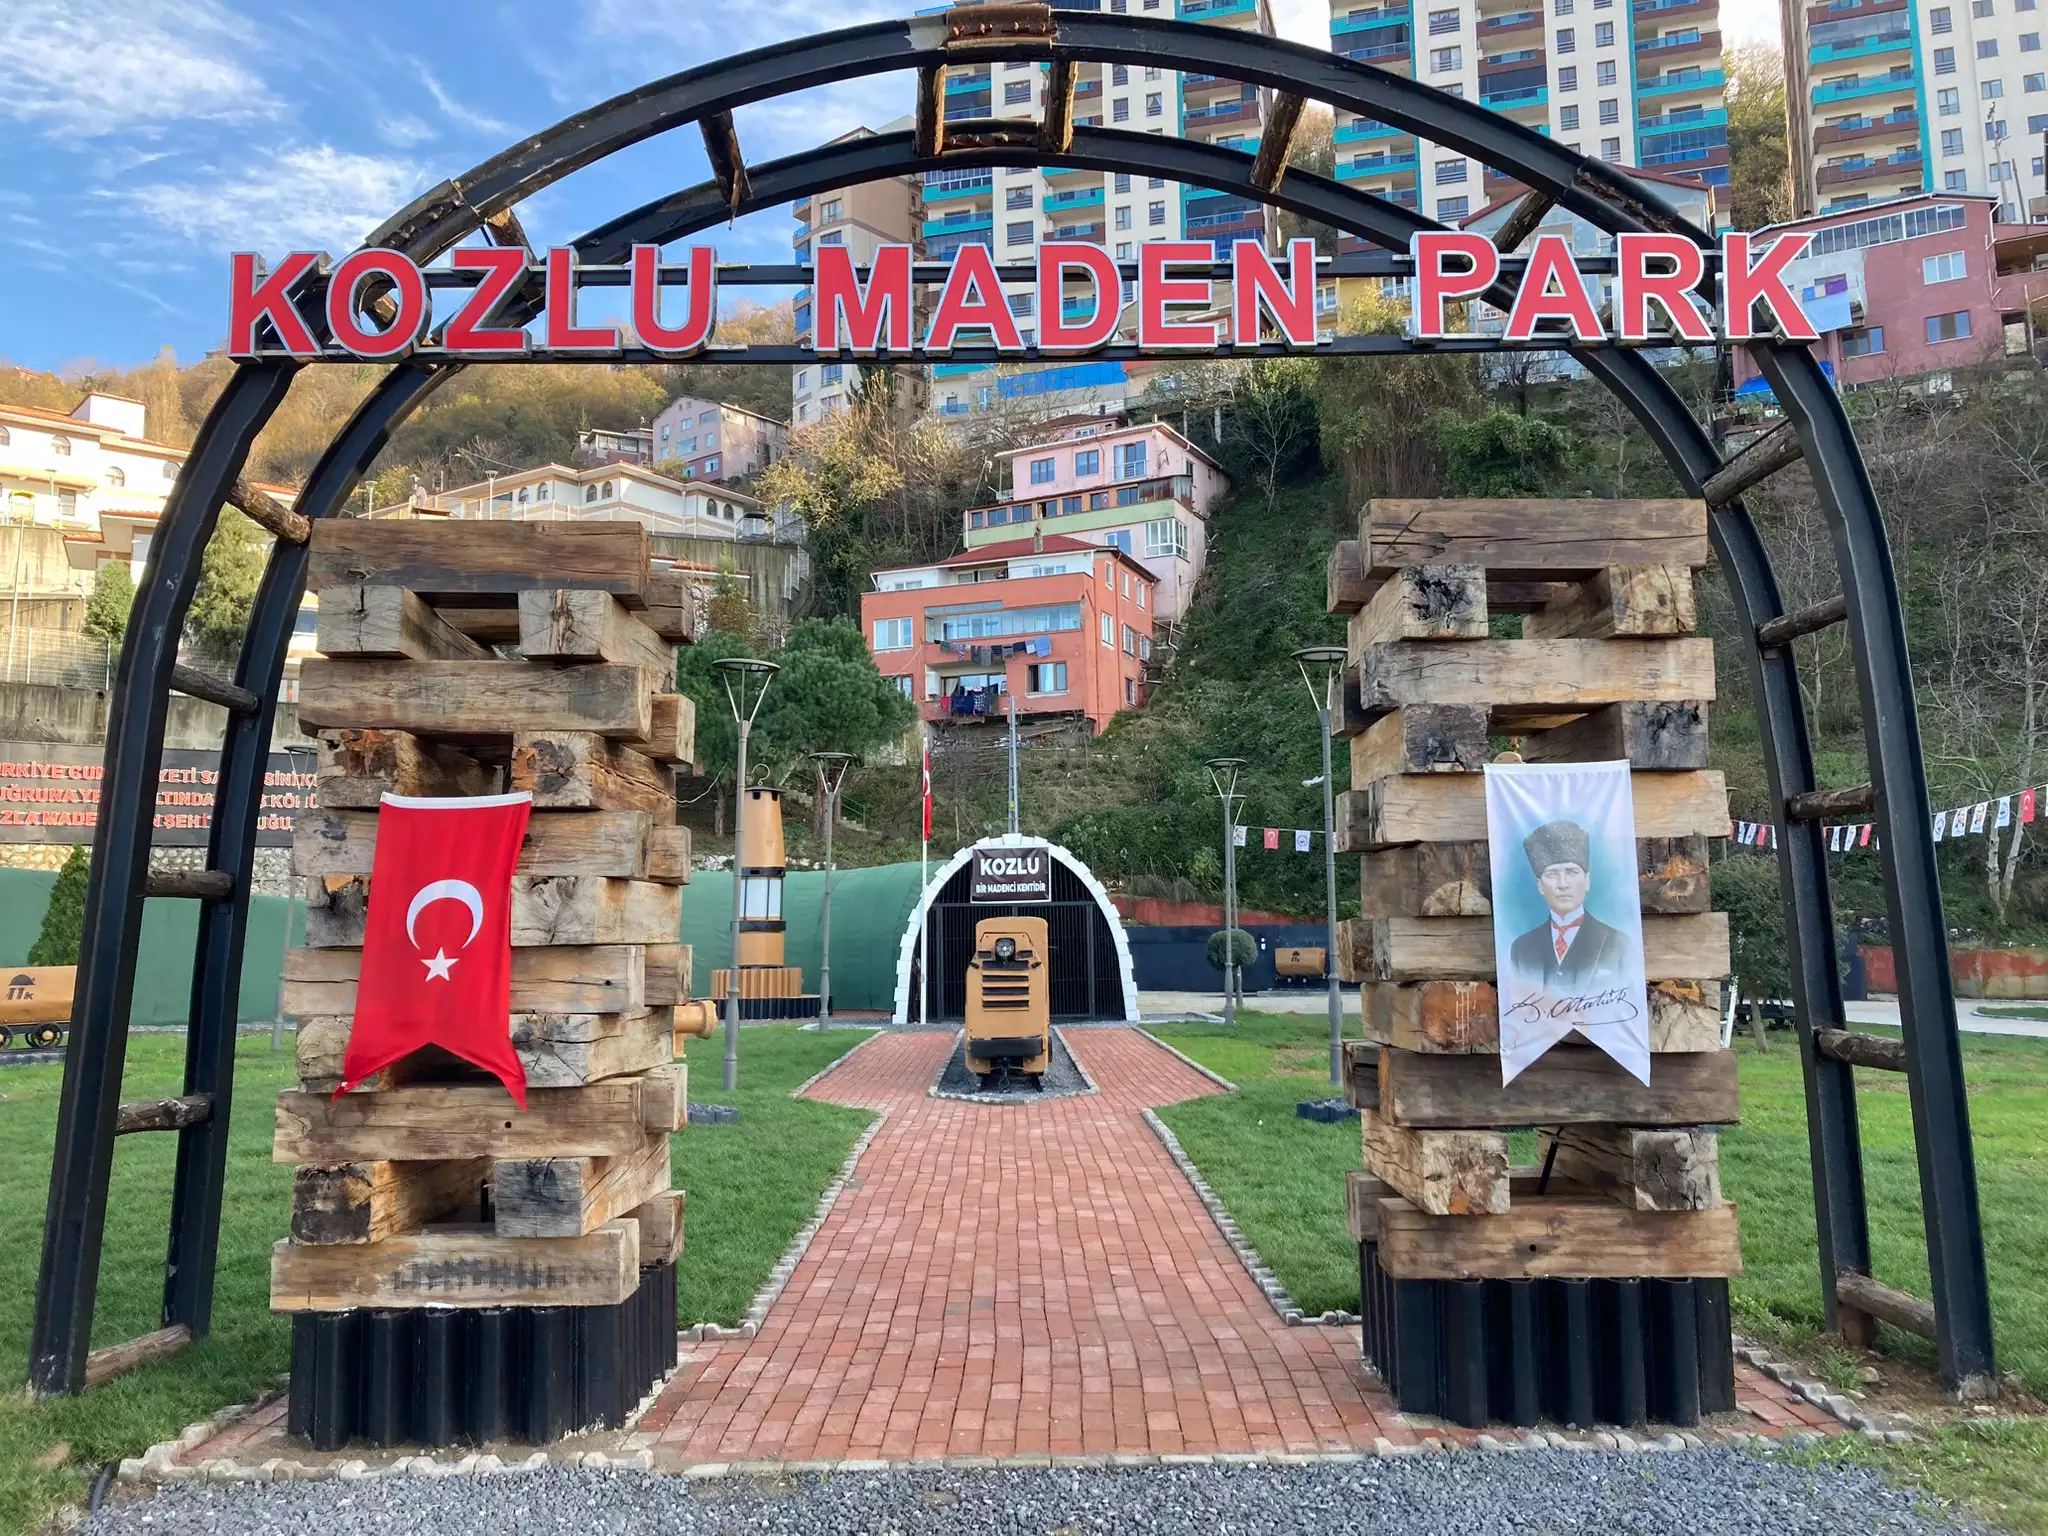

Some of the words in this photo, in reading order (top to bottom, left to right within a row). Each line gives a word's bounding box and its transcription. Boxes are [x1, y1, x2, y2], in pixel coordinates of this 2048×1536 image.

[228, 243, 719, 360] KOZLU
[812, 238, 1319, 356] MADEN
[1409, 231, 1821, 344] PARK
[0, 761, 64, 778] RKİYE
[980, 857, 1039, 875] KOZLU
[975, 882, 987, 893] BİR
[987, 881, 1016, 893] MADENCİ
[1017, 880, 1046, 892] KENTİDİR
